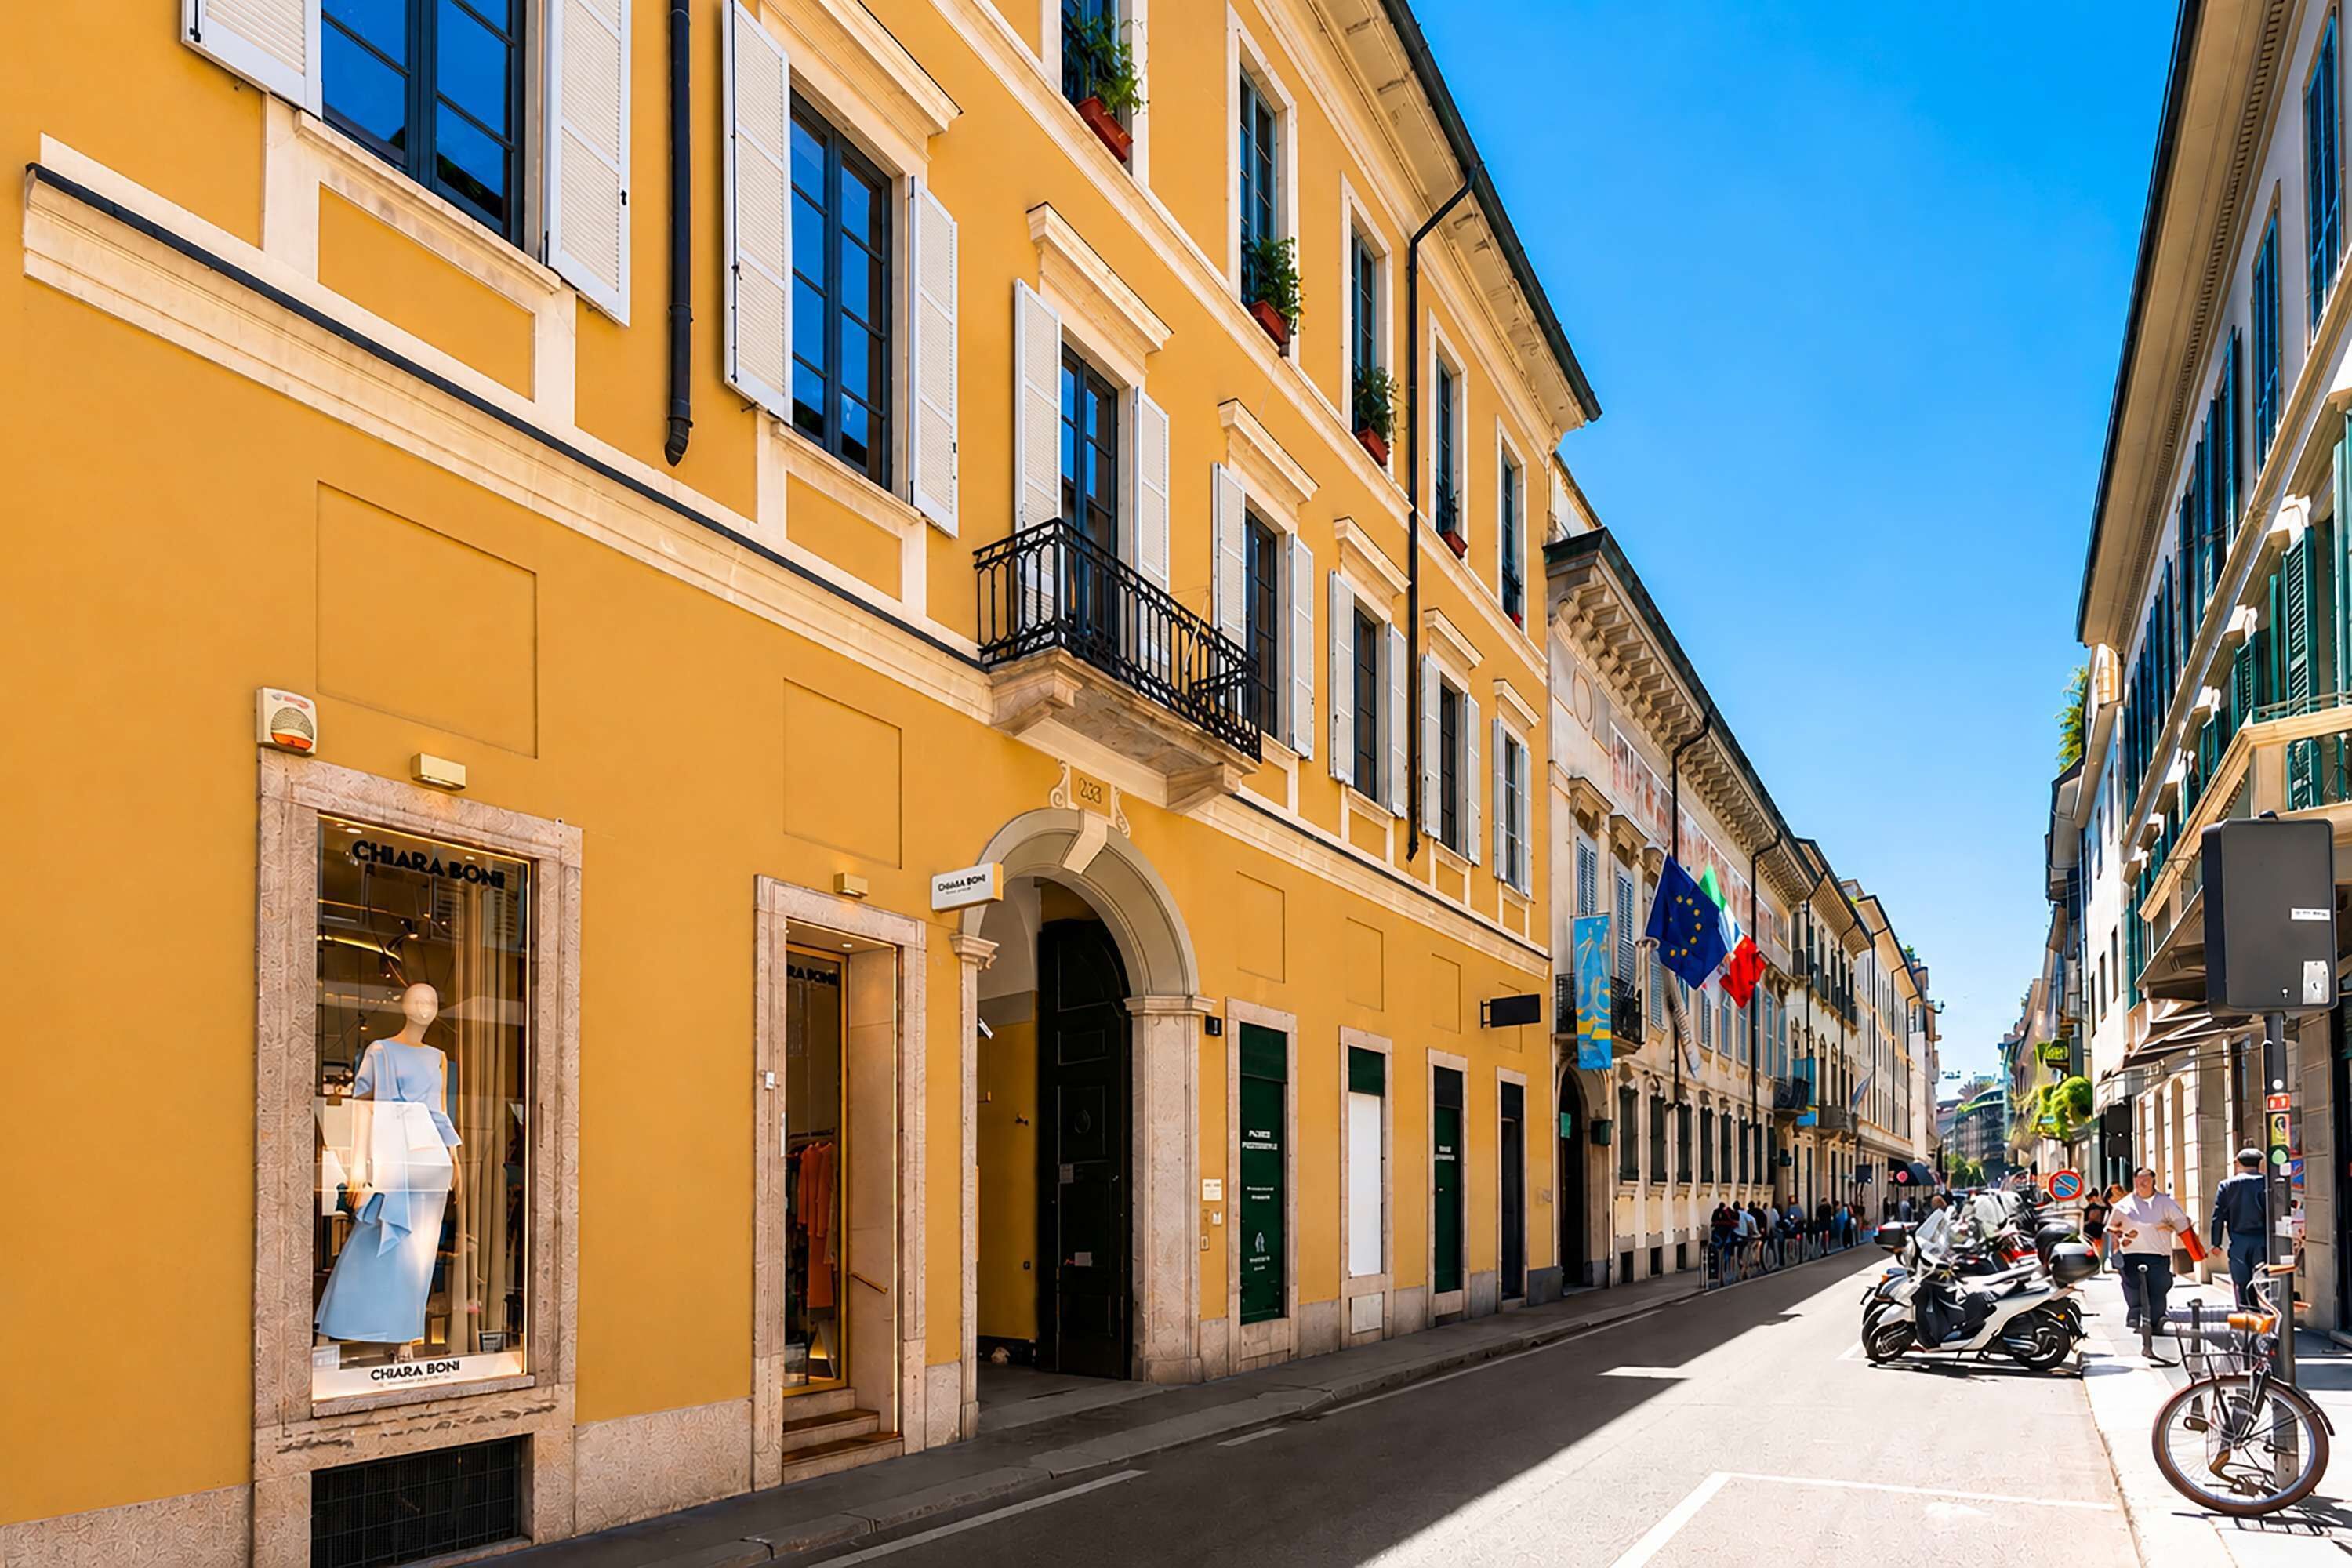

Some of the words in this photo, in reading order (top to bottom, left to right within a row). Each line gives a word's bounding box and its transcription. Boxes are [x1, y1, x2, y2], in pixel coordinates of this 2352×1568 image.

[352, 840, 445, 877] CHIARA
[448, 861, 506, 890] BONI
[370, 1365, 423, 1381] CHIARA
[426, 1359, 460, 1374] BONI
